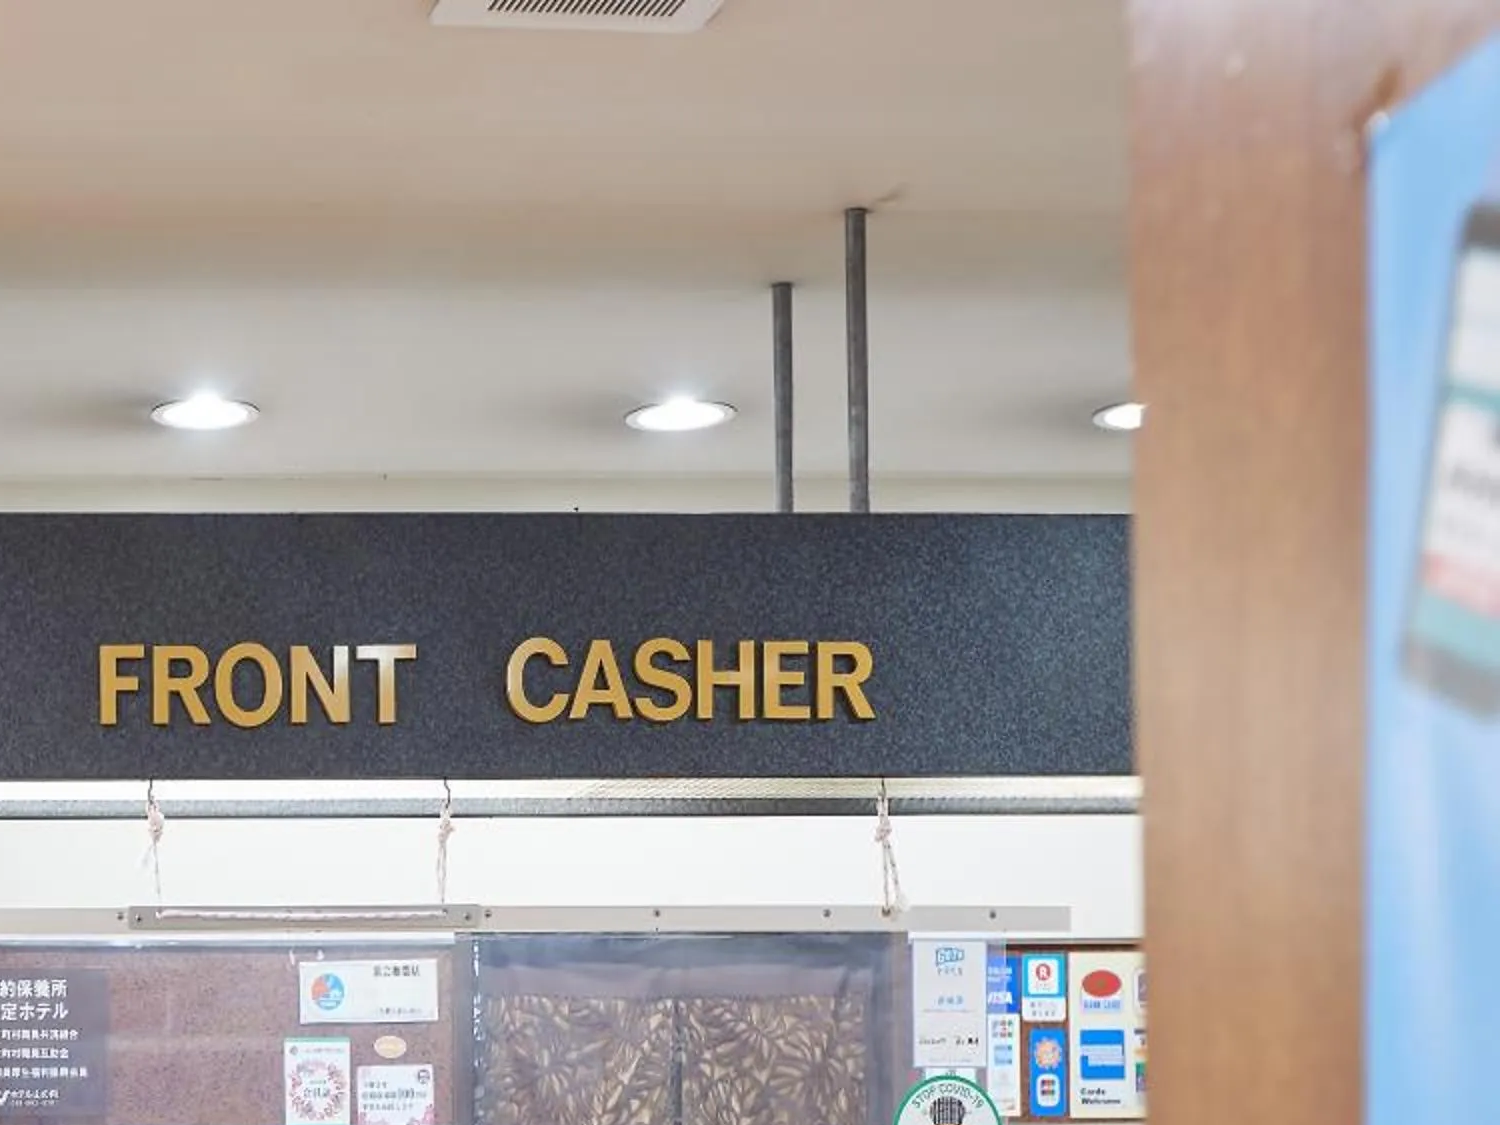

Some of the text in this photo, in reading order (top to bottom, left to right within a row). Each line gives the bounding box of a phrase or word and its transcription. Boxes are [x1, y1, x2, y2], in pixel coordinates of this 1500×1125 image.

[98, 636, 876, 727] FRONT CASHER
[911, 1083, 985, 1109] STOP COVID-19
